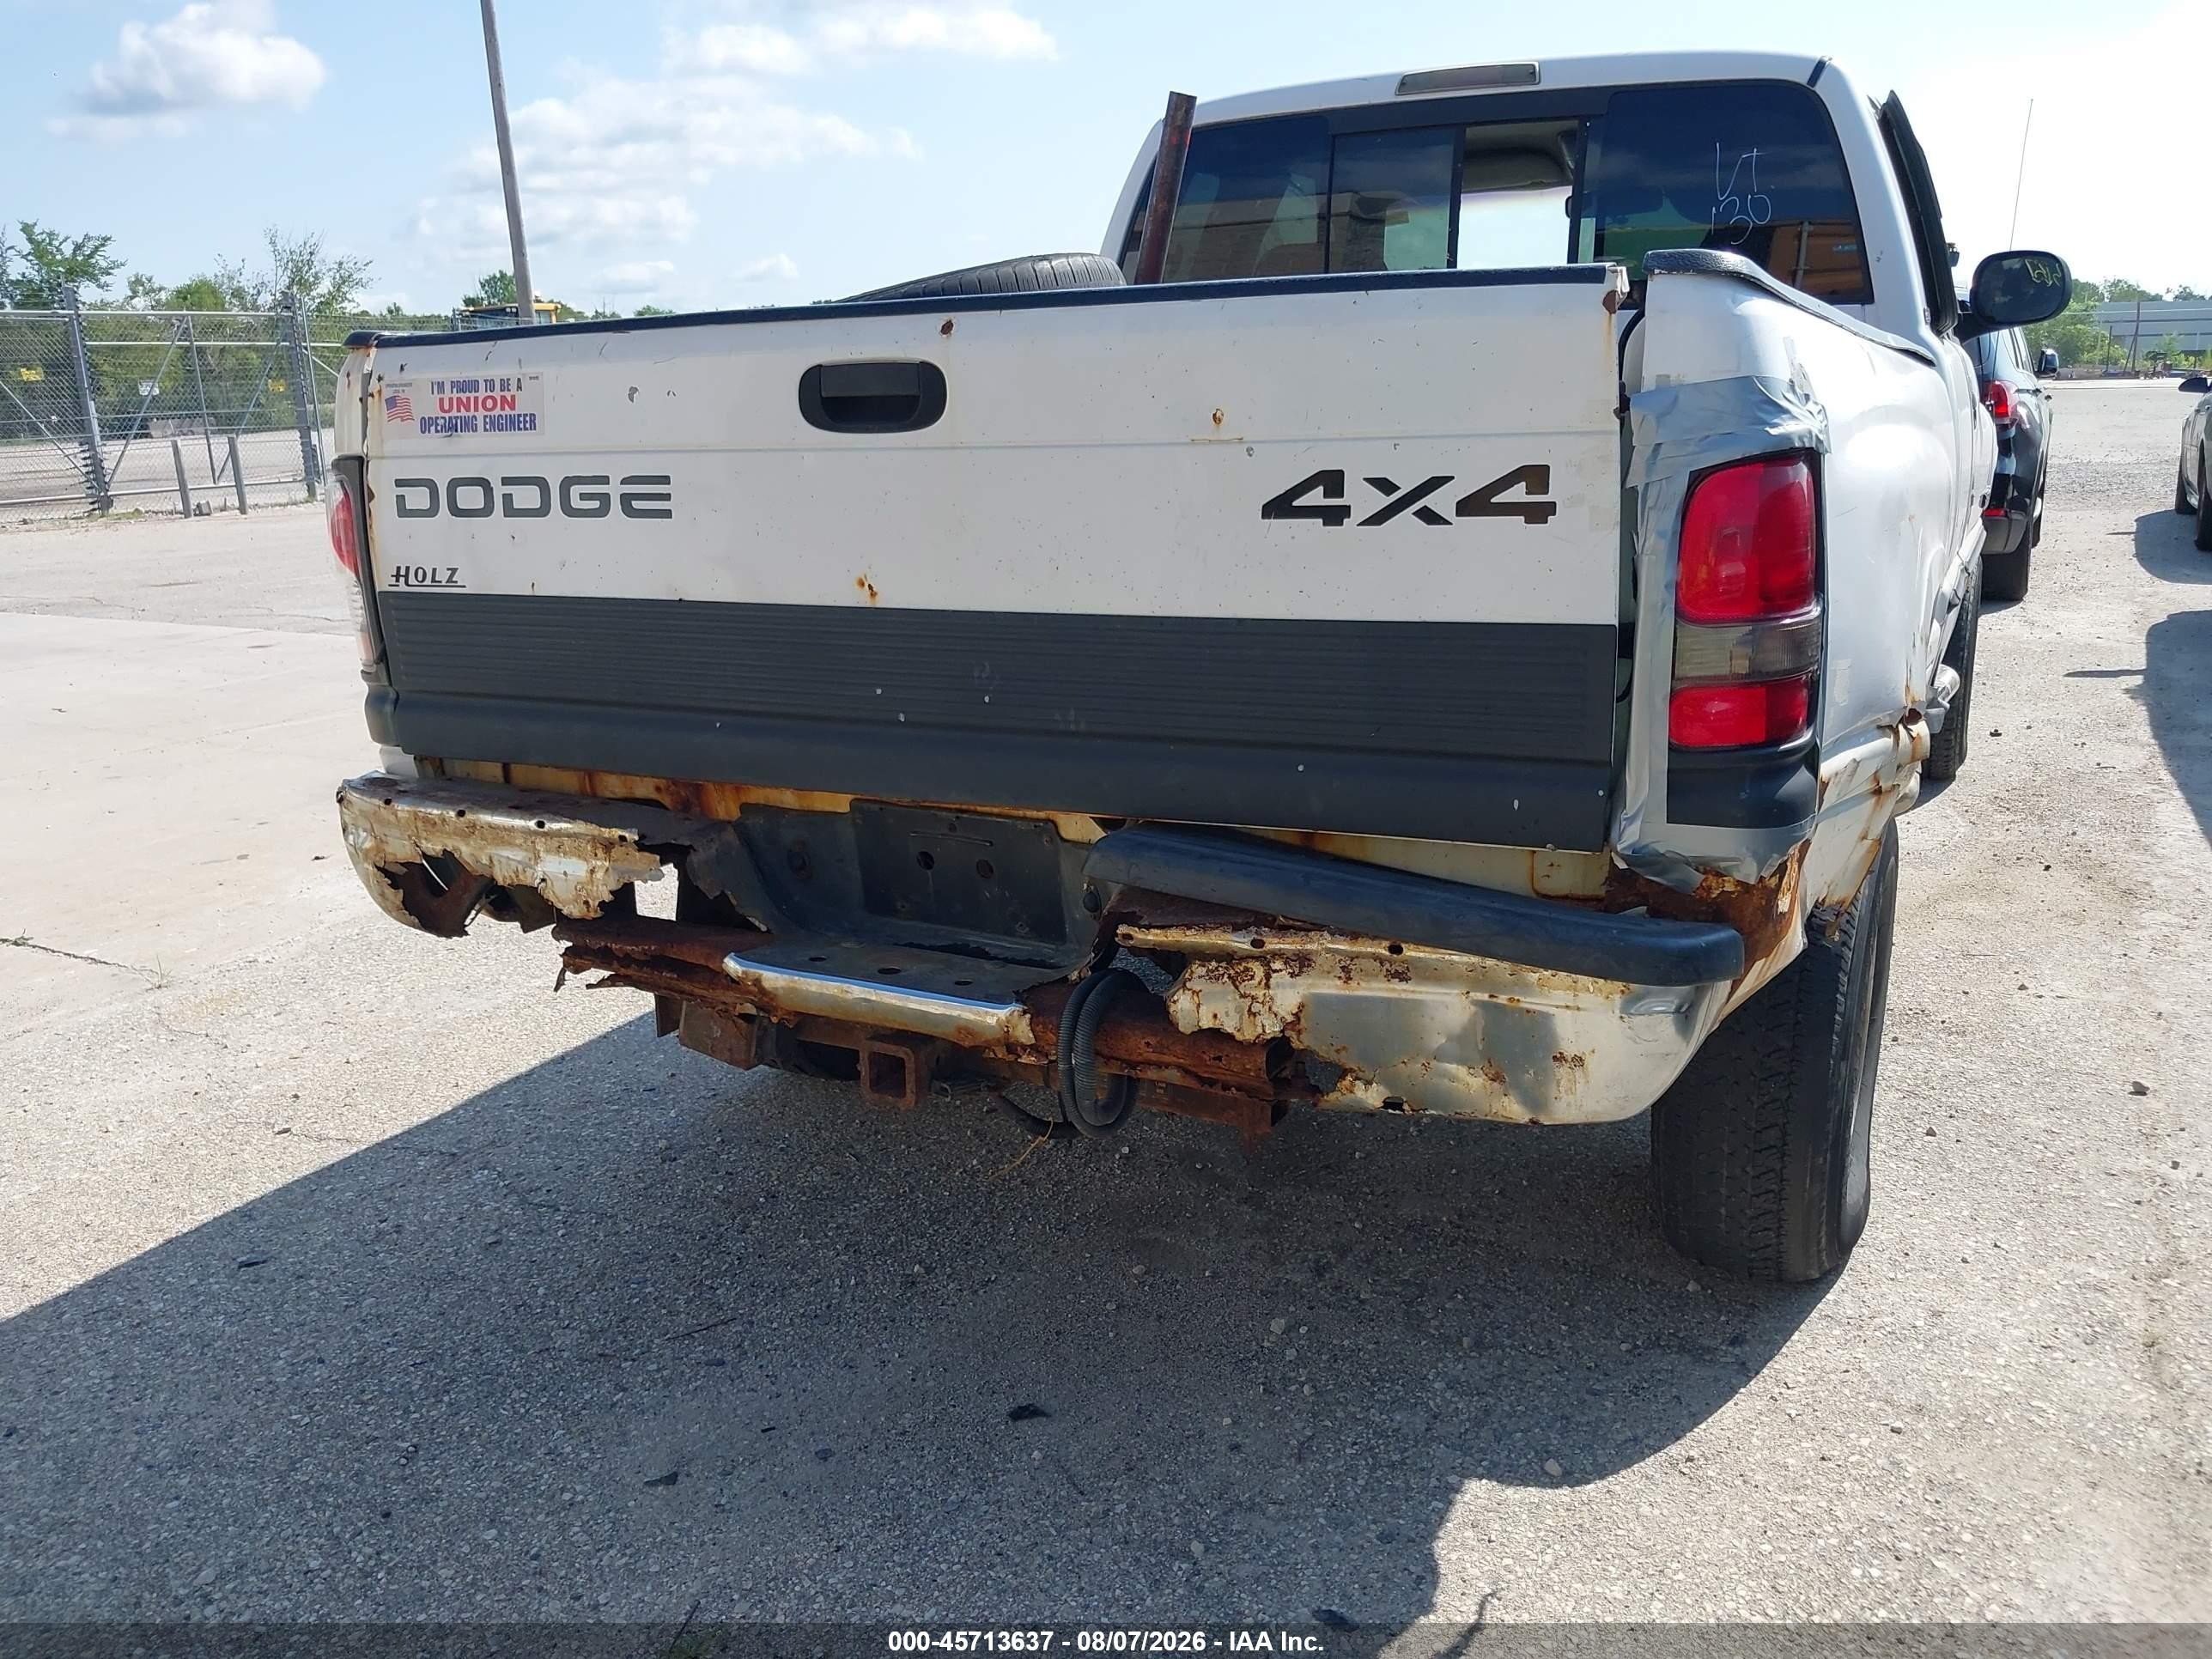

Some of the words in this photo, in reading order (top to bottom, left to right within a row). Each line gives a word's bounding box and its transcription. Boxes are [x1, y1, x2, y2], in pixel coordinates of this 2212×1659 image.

[431, 380, 445, 395] I'M
[451, 380, 480, 394] PROUD
[483, 379, 495, 393] TO
[500, 378, 512, 392] BE
[516, 378, 523, 392] A
[439, 394, 516, 413] UNION
[419, 415, 478, 434] OPERATING
[483, 413, 537, 432] ENGINEER
[394, 475, 673, 519] DODGE
[1261, 465, 1557, 526] 4X4
[389, 565, 463, 587] HOLZ
